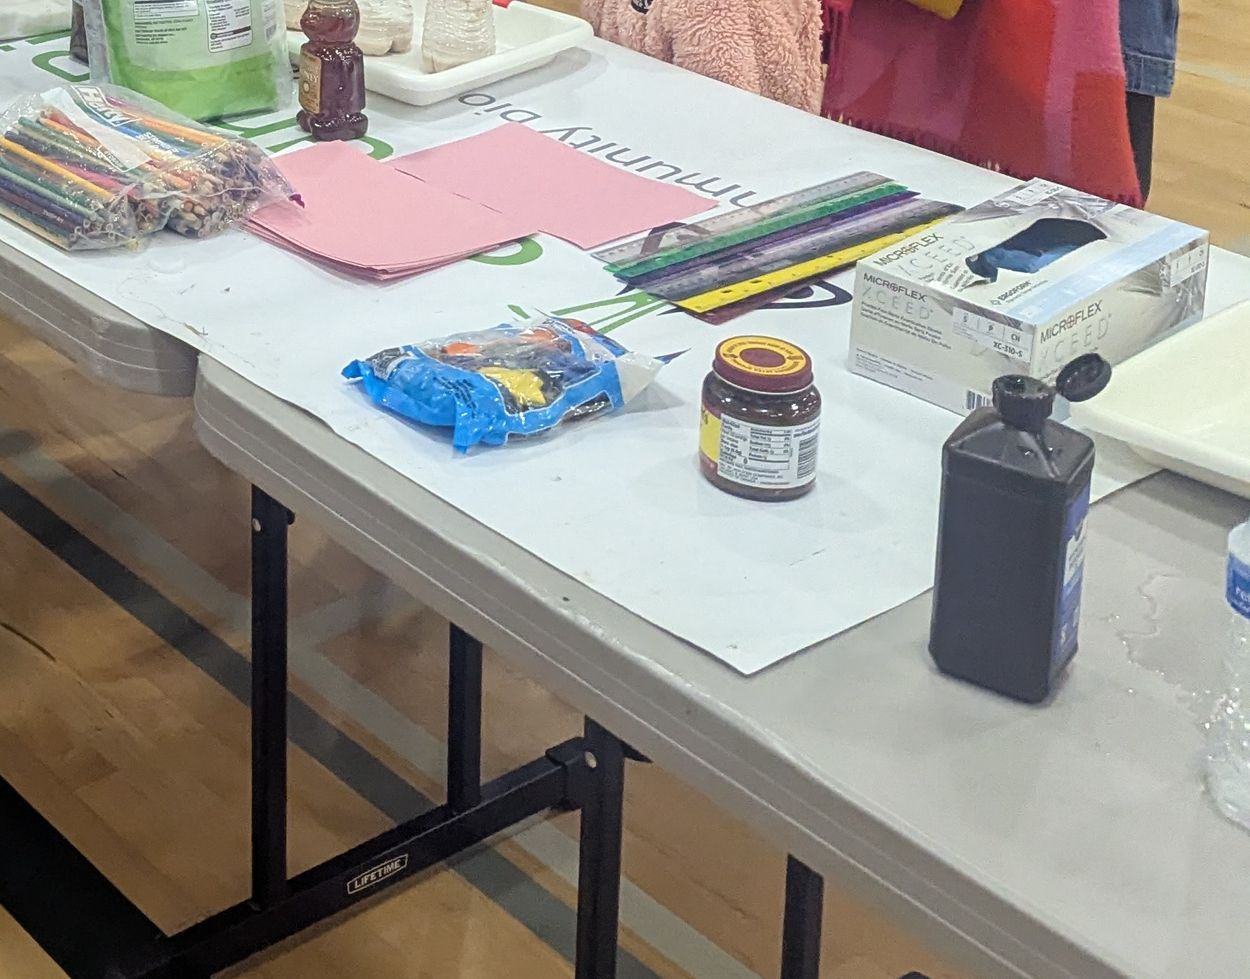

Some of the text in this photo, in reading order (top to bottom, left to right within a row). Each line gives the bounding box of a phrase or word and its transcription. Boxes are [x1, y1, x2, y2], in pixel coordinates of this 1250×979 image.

[873, 233, 944, 266] MICROFLEX
[863, 273, 927, 302] MICROFLEX
[1040, 299, 1103, 343] MICROFLEX
[354, 860, 402, 889] LIFETIME
